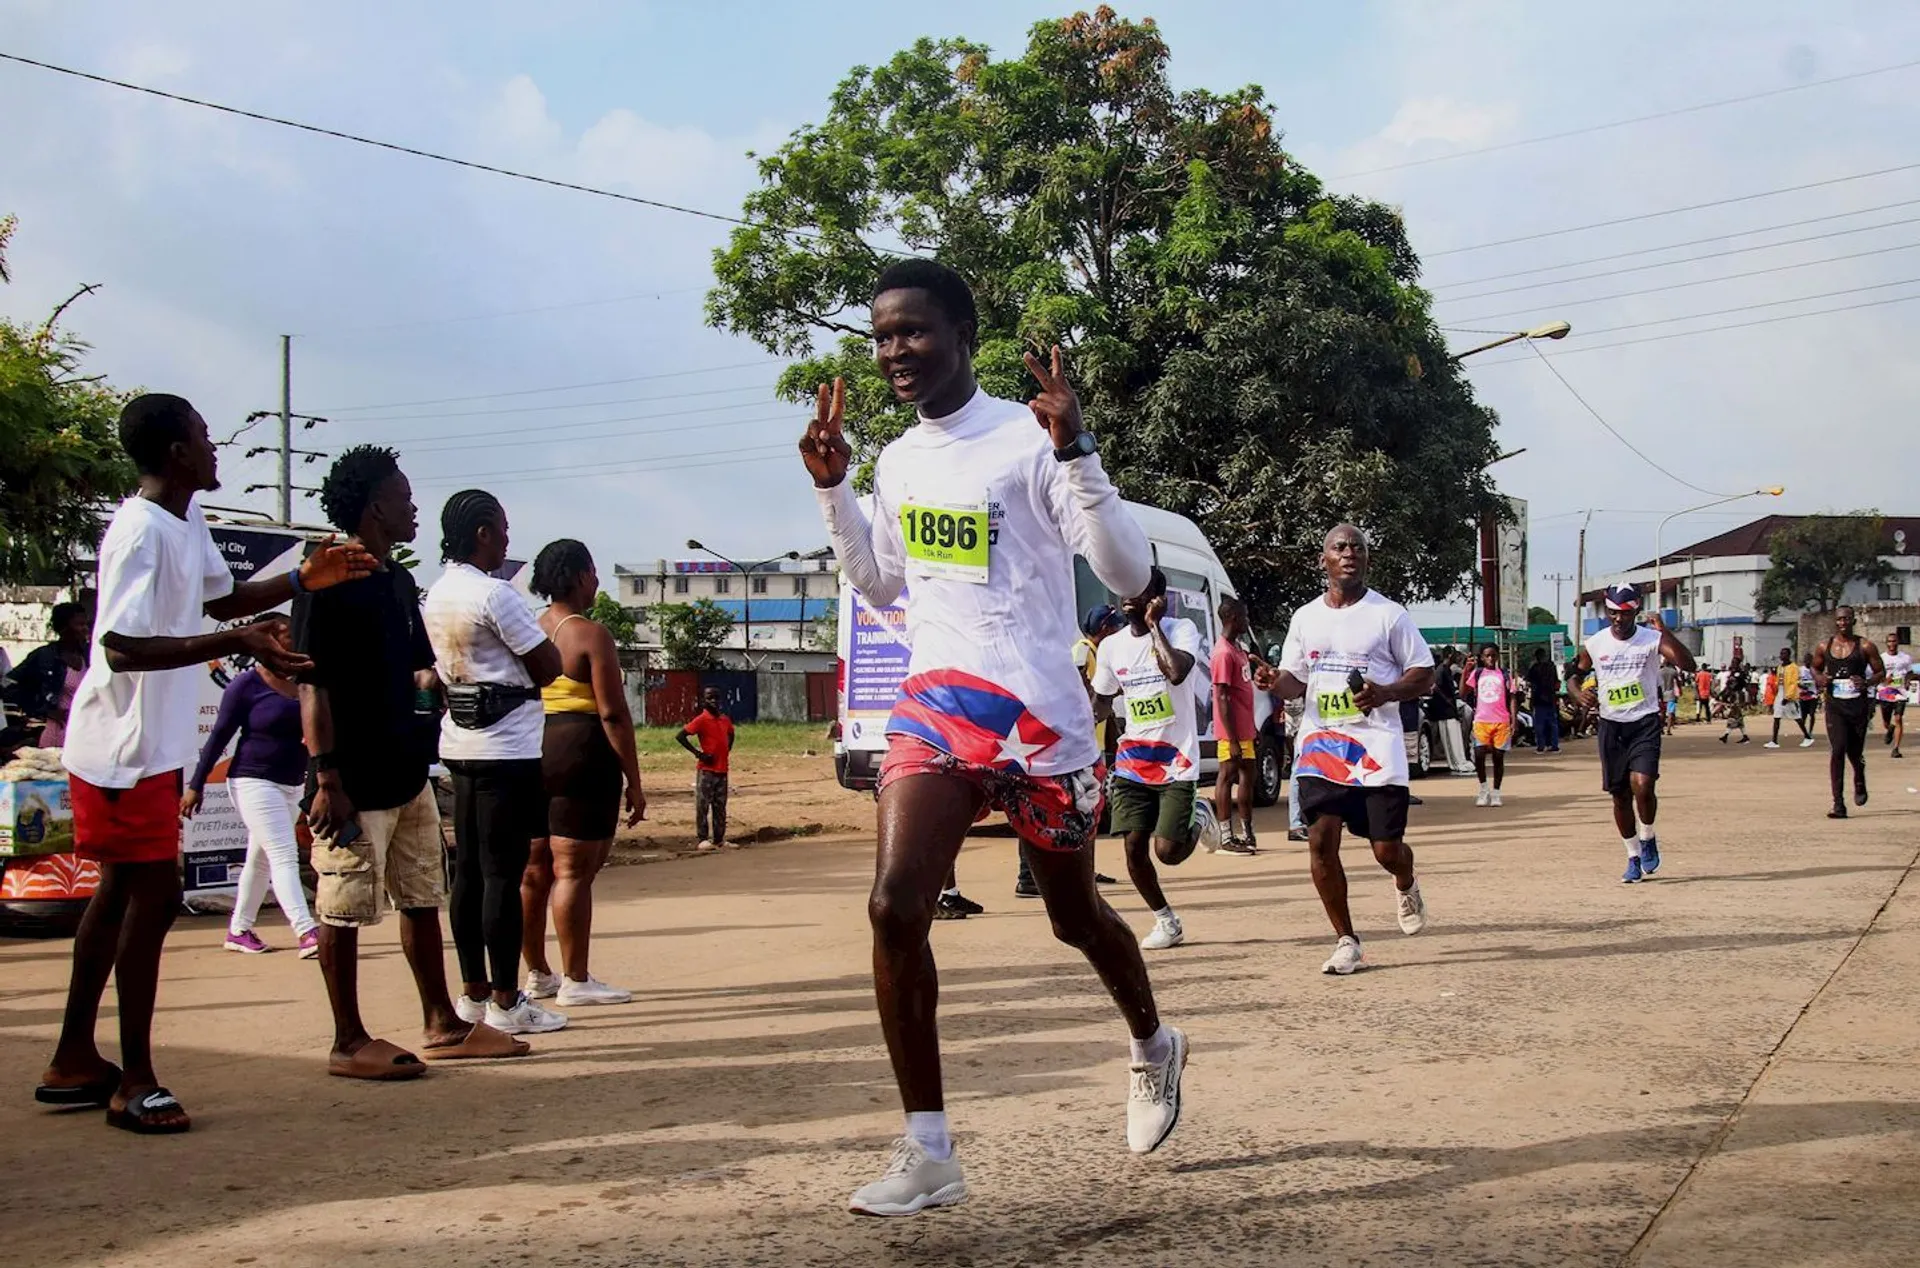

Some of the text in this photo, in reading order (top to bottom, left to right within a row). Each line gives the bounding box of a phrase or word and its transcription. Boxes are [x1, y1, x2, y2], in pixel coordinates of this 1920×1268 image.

[906, 509, 977, 550] 1896
[228, 542, 247, 555] City
[923, 548, 953, 559] 10k Run
[1321, 692, 1350, 711] 741
[1607, 684, 1639, 701] 2176
[1130, 697, 1165, 716] 1251
